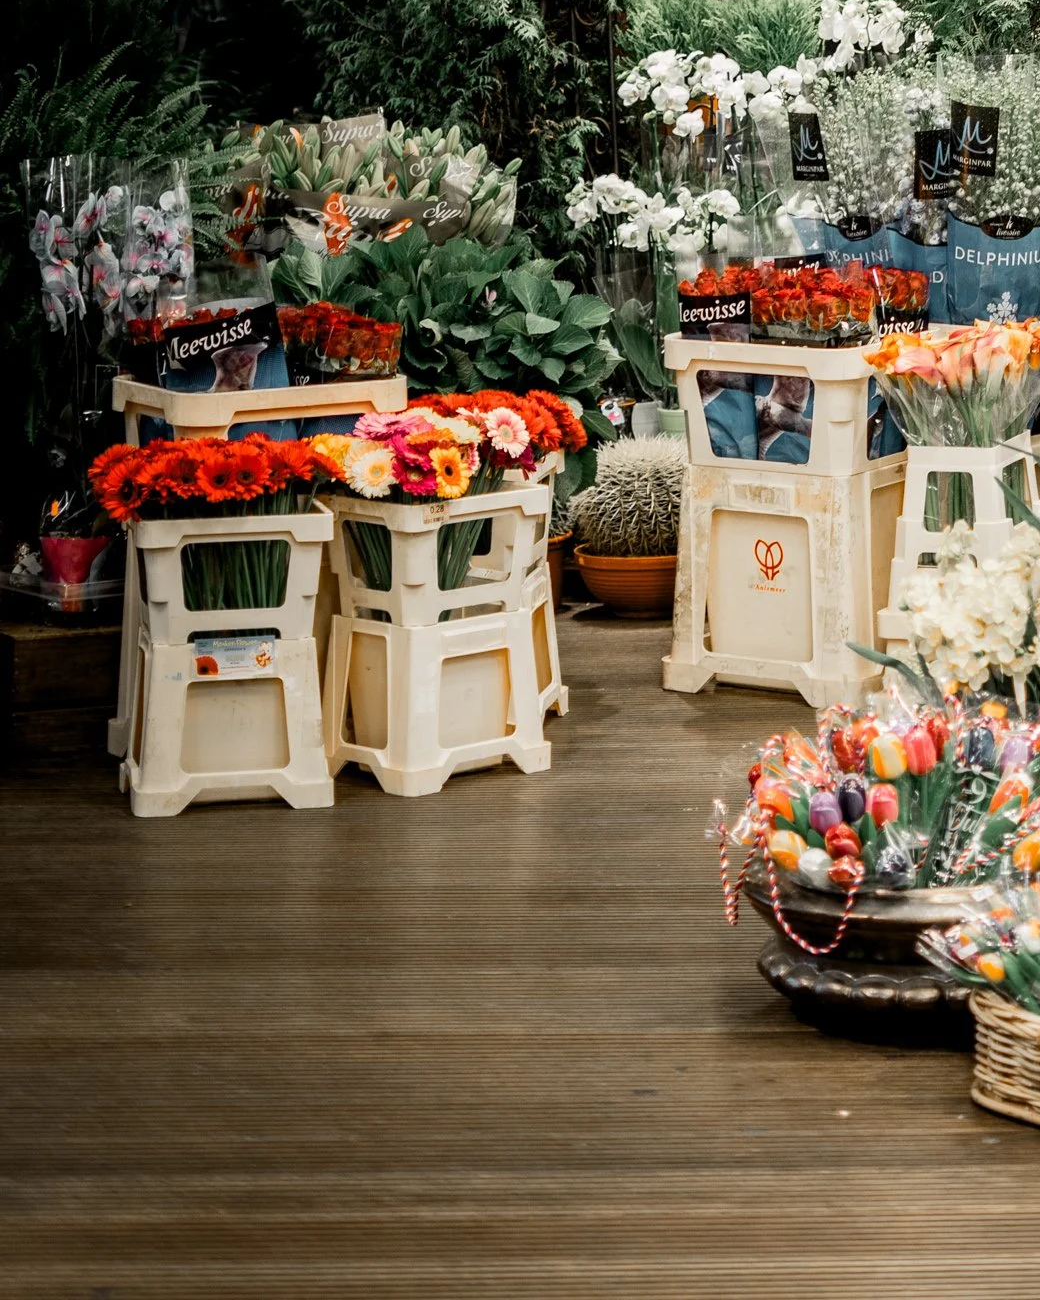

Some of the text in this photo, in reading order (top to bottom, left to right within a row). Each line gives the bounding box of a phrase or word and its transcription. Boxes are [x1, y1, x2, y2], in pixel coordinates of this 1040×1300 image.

[321, 120, 377, 147] Supra
[952, 153, 992, 168] MARGINPAR
[326, 194, 392, 223] Supra
[679, 298, 746, 323] eewisse
